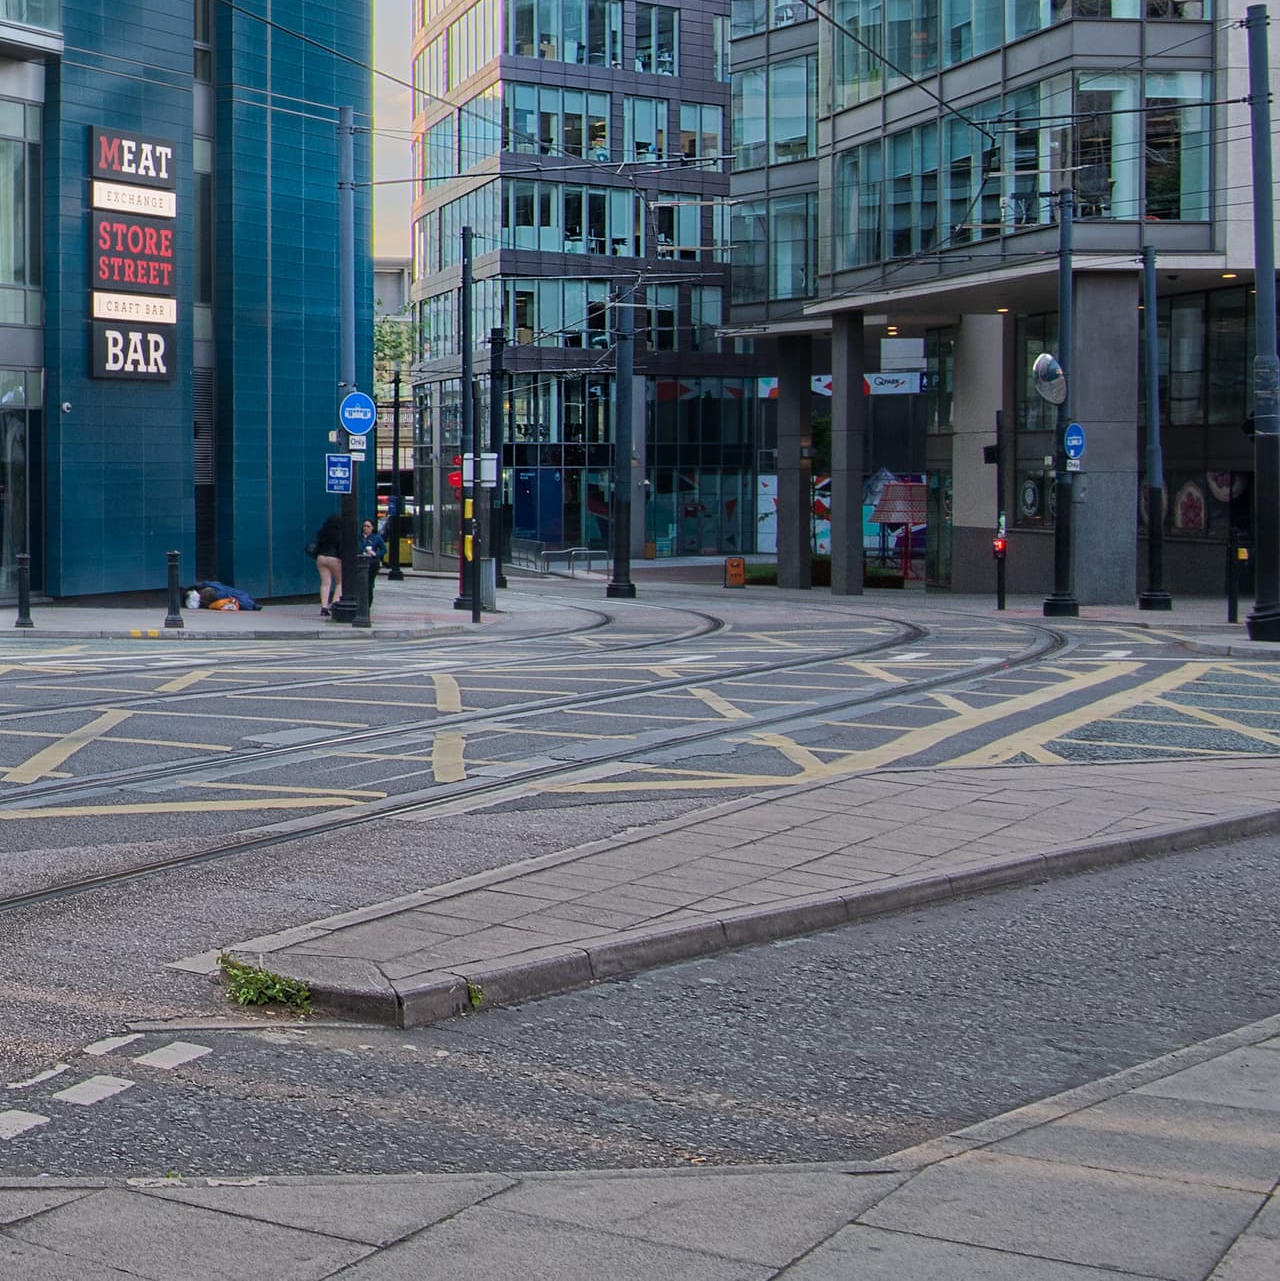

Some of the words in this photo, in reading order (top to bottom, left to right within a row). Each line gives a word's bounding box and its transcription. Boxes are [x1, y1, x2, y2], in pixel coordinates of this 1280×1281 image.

[98, 135, 172, 179] MEAT
[106, 190, 165, 209] EXCHANGE
[98, 221, 172, 257] STORE
[98, 256, 172, 286] STREET
[106, 300, 141, 315] CRAFT
[145, 301, 165, 316] BAR
[104, 330, 167, 373] BAR
[350, 438, 365, 447] Only
